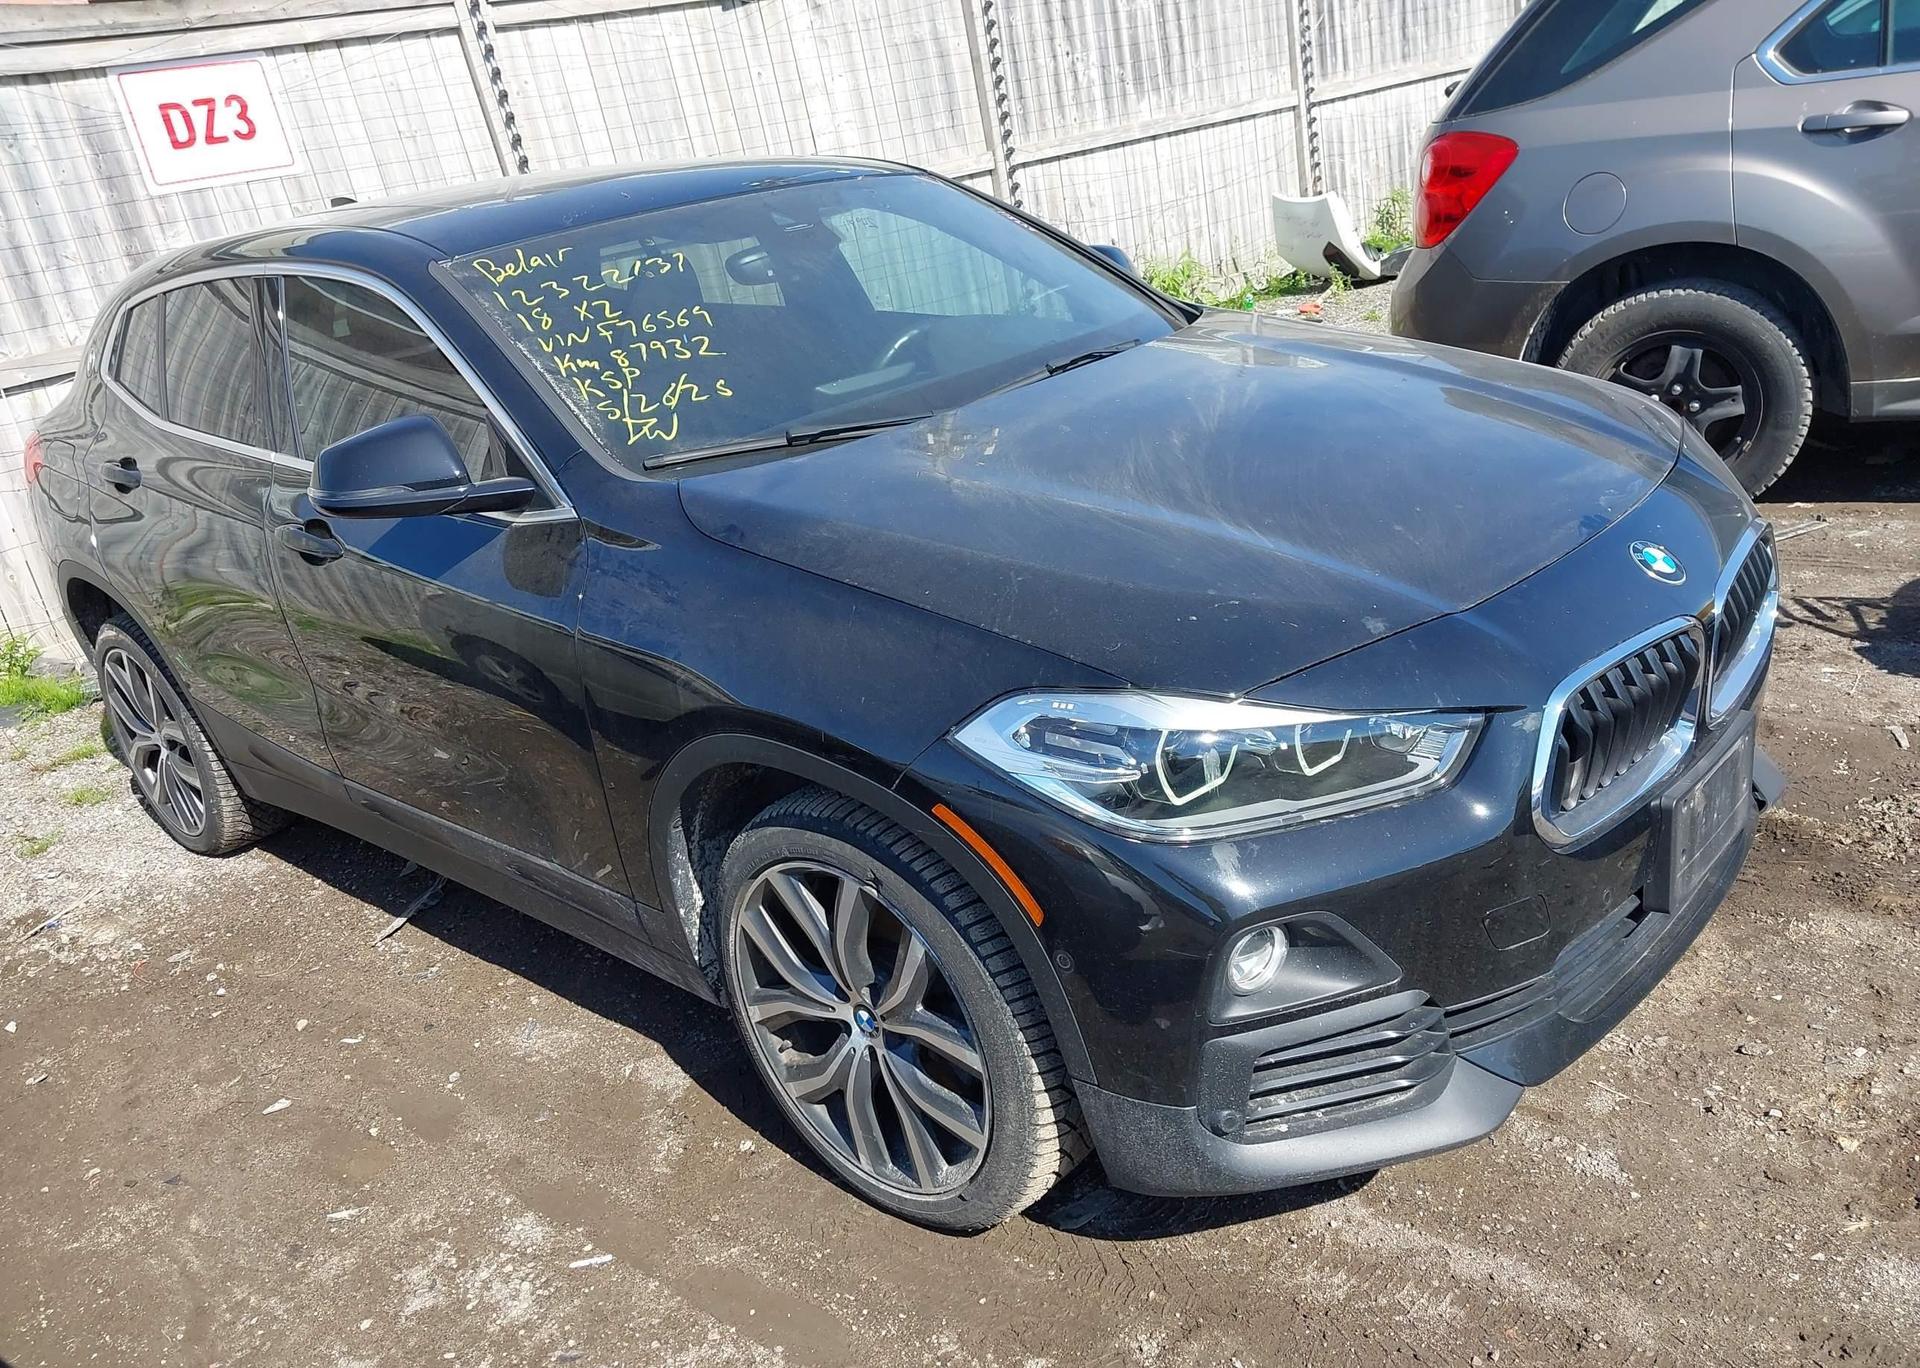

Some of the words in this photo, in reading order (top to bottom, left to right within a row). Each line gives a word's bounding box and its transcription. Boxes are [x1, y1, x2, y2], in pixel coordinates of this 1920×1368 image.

[158, 94, 257, 150] DZ3
[472, 247, 574, 287] Belair
[516, 307, 552, 332] 18
[537, 326, 590, 352] VIN
[610, 336, 727, 368] 87932
